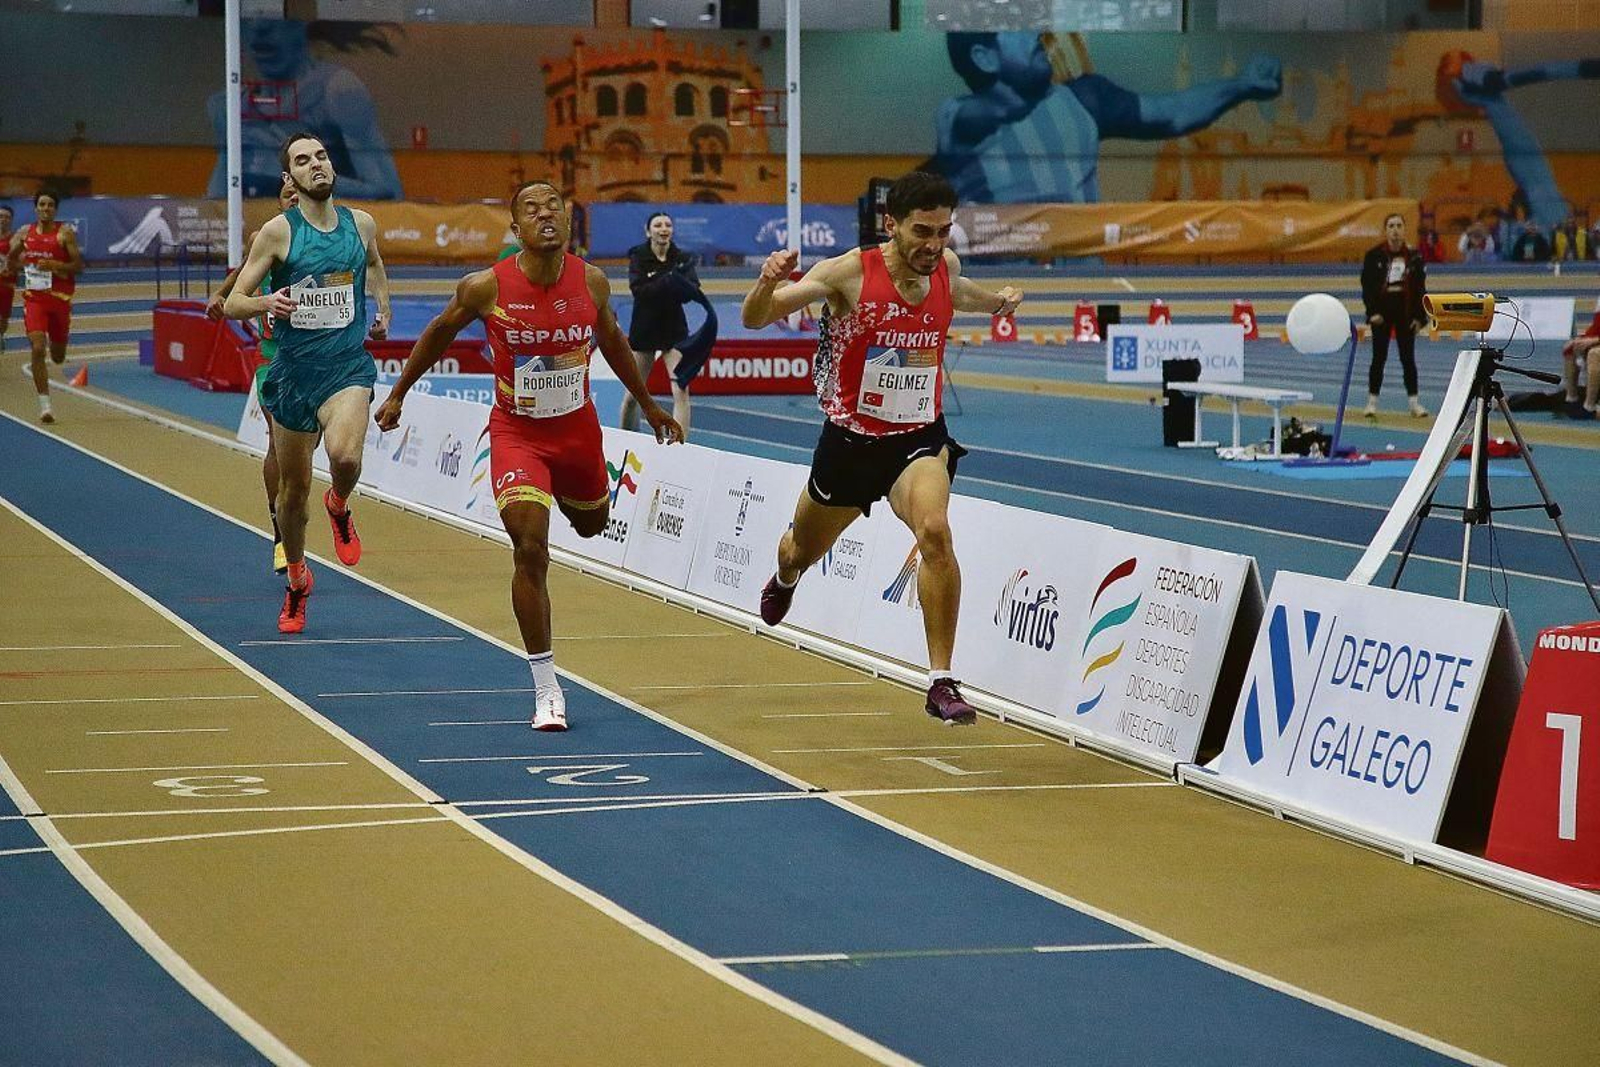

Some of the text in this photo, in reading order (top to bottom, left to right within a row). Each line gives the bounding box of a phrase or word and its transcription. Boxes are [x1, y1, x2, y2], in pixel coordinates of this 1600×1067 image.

[231, 72, 239, 84] 3
[232, 175, 240, 187] 2
[299, 290, 348, 307] ANGELOV
[339, 307, 350, 319] 55
[505, 324, 594, 345] ESPAÑA
[996, 316, 1012, 336] 6
[1079, 314, 1094, 336] 5
[1144, 340, 1202, 352] XUNTA
[709, 357, 809, 379] MONDO
[522, 371, 581, 391] RODRÍGUEZ
[877, 372, 929, 391] EGILMEZ
[917, 396, 930, 412] 97
[838, 537, 864, 558] DEPORTE
[833, 560, 857, 581] GALEGO
[1154, 566, 1223, 604] FEDERACIÓN
[1008, 585, 1060, 652] virtus
[1144, 602, 1198, 638] ESPAÑOLA
[1135, 637, 1190, 674] DEPORTES
[1330, 634, 1473, 713] DEPORTE
[1126, 674, 1201, 718] DISCAPACIDAD
[1115, 709, 1182, 754] INTELECTUAL
[1309, 716, 1432, 795] GALEGO
[526, 763, 650, 786] 2
[1546, 712, 1582, 841] 1
[152, 775, 271, 798] 3
